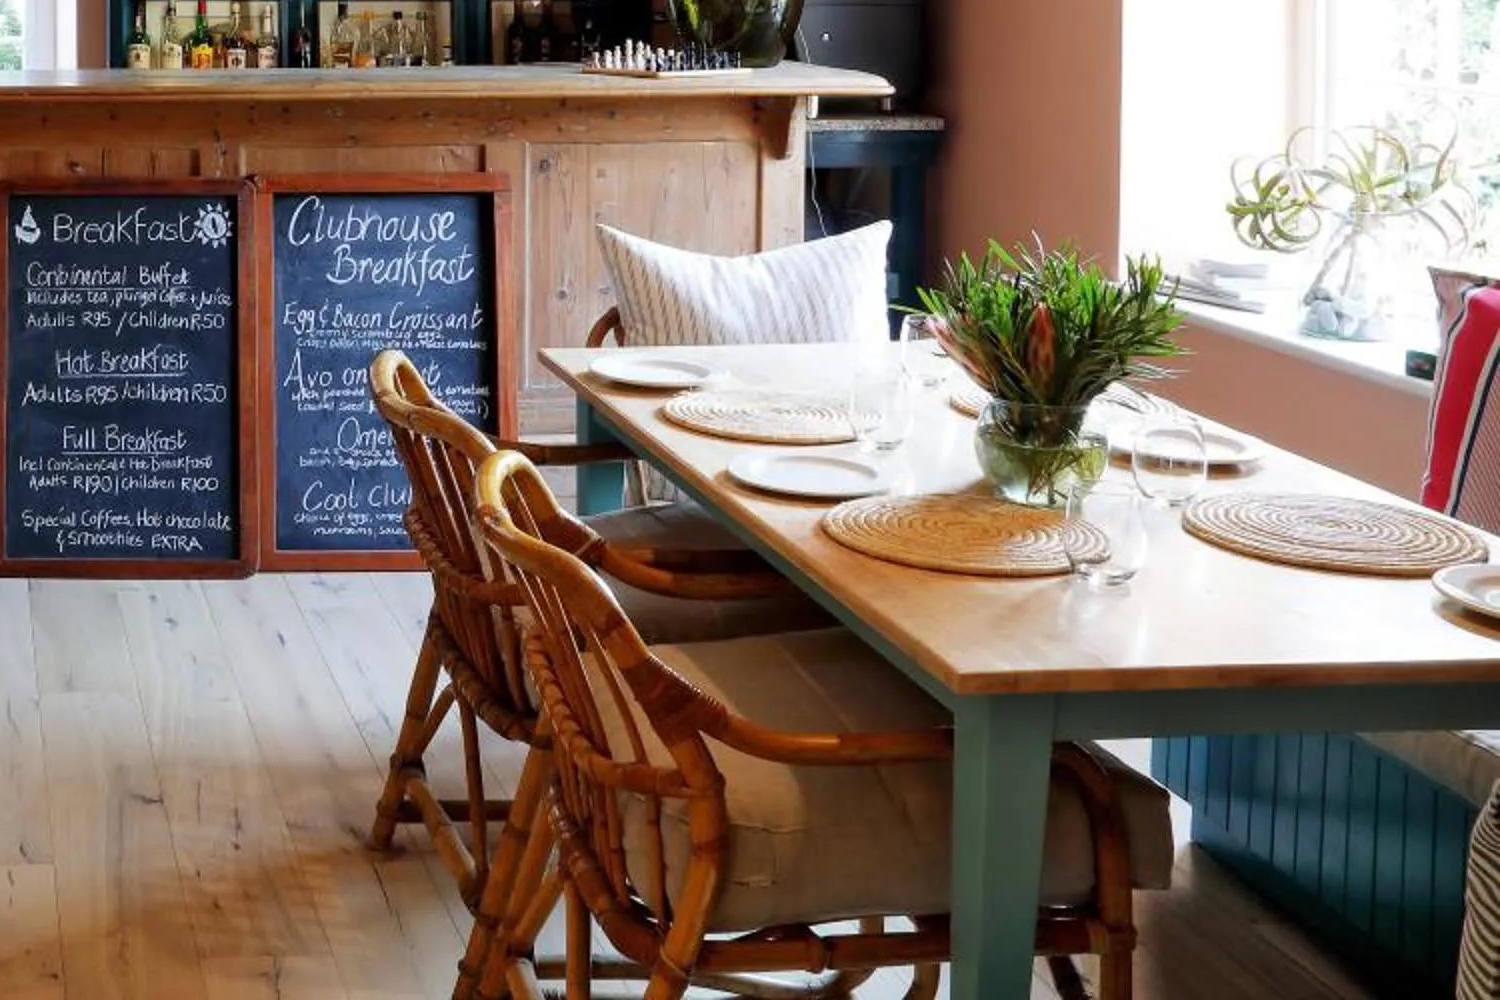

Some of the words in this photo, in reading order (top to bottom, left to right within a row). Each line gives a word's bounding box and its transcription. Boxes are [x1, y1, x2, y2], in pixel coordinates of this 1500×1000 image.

[54, 207, 197, 245] Breakfast
[288, 195, 457, 247] Clubhouse
[26, 261, 128, 287] Continental
[139, 261, 191, 287] Buffet
[326, 243, 476, 297] Breakfast
[82, 311, 112, 329] R95
[190, 312, 226, 331] R50
[283, 301, 316, 335] Egg
[332, 302, 382, 330] Bacon
[389, 301, 484, 330] Croissant
[55, 349, 96, 375] Hot
[99, 344, 190, 373] Breakfast
[283, 347, 333, 389] Avo
[343, 367, 369, 386] on
[21, 381, 83, 407] Adults
[86, 384, 119, 405] R95
[191, 383, 227, 403] R50
[62, 425, 97, 450] Full
[104, 424, 188, 453] Breakfast
[21, 505, 76, 532] Special
[137, 508, 163, 528] Hot
[151, 533, 204, 552] EXTRA
